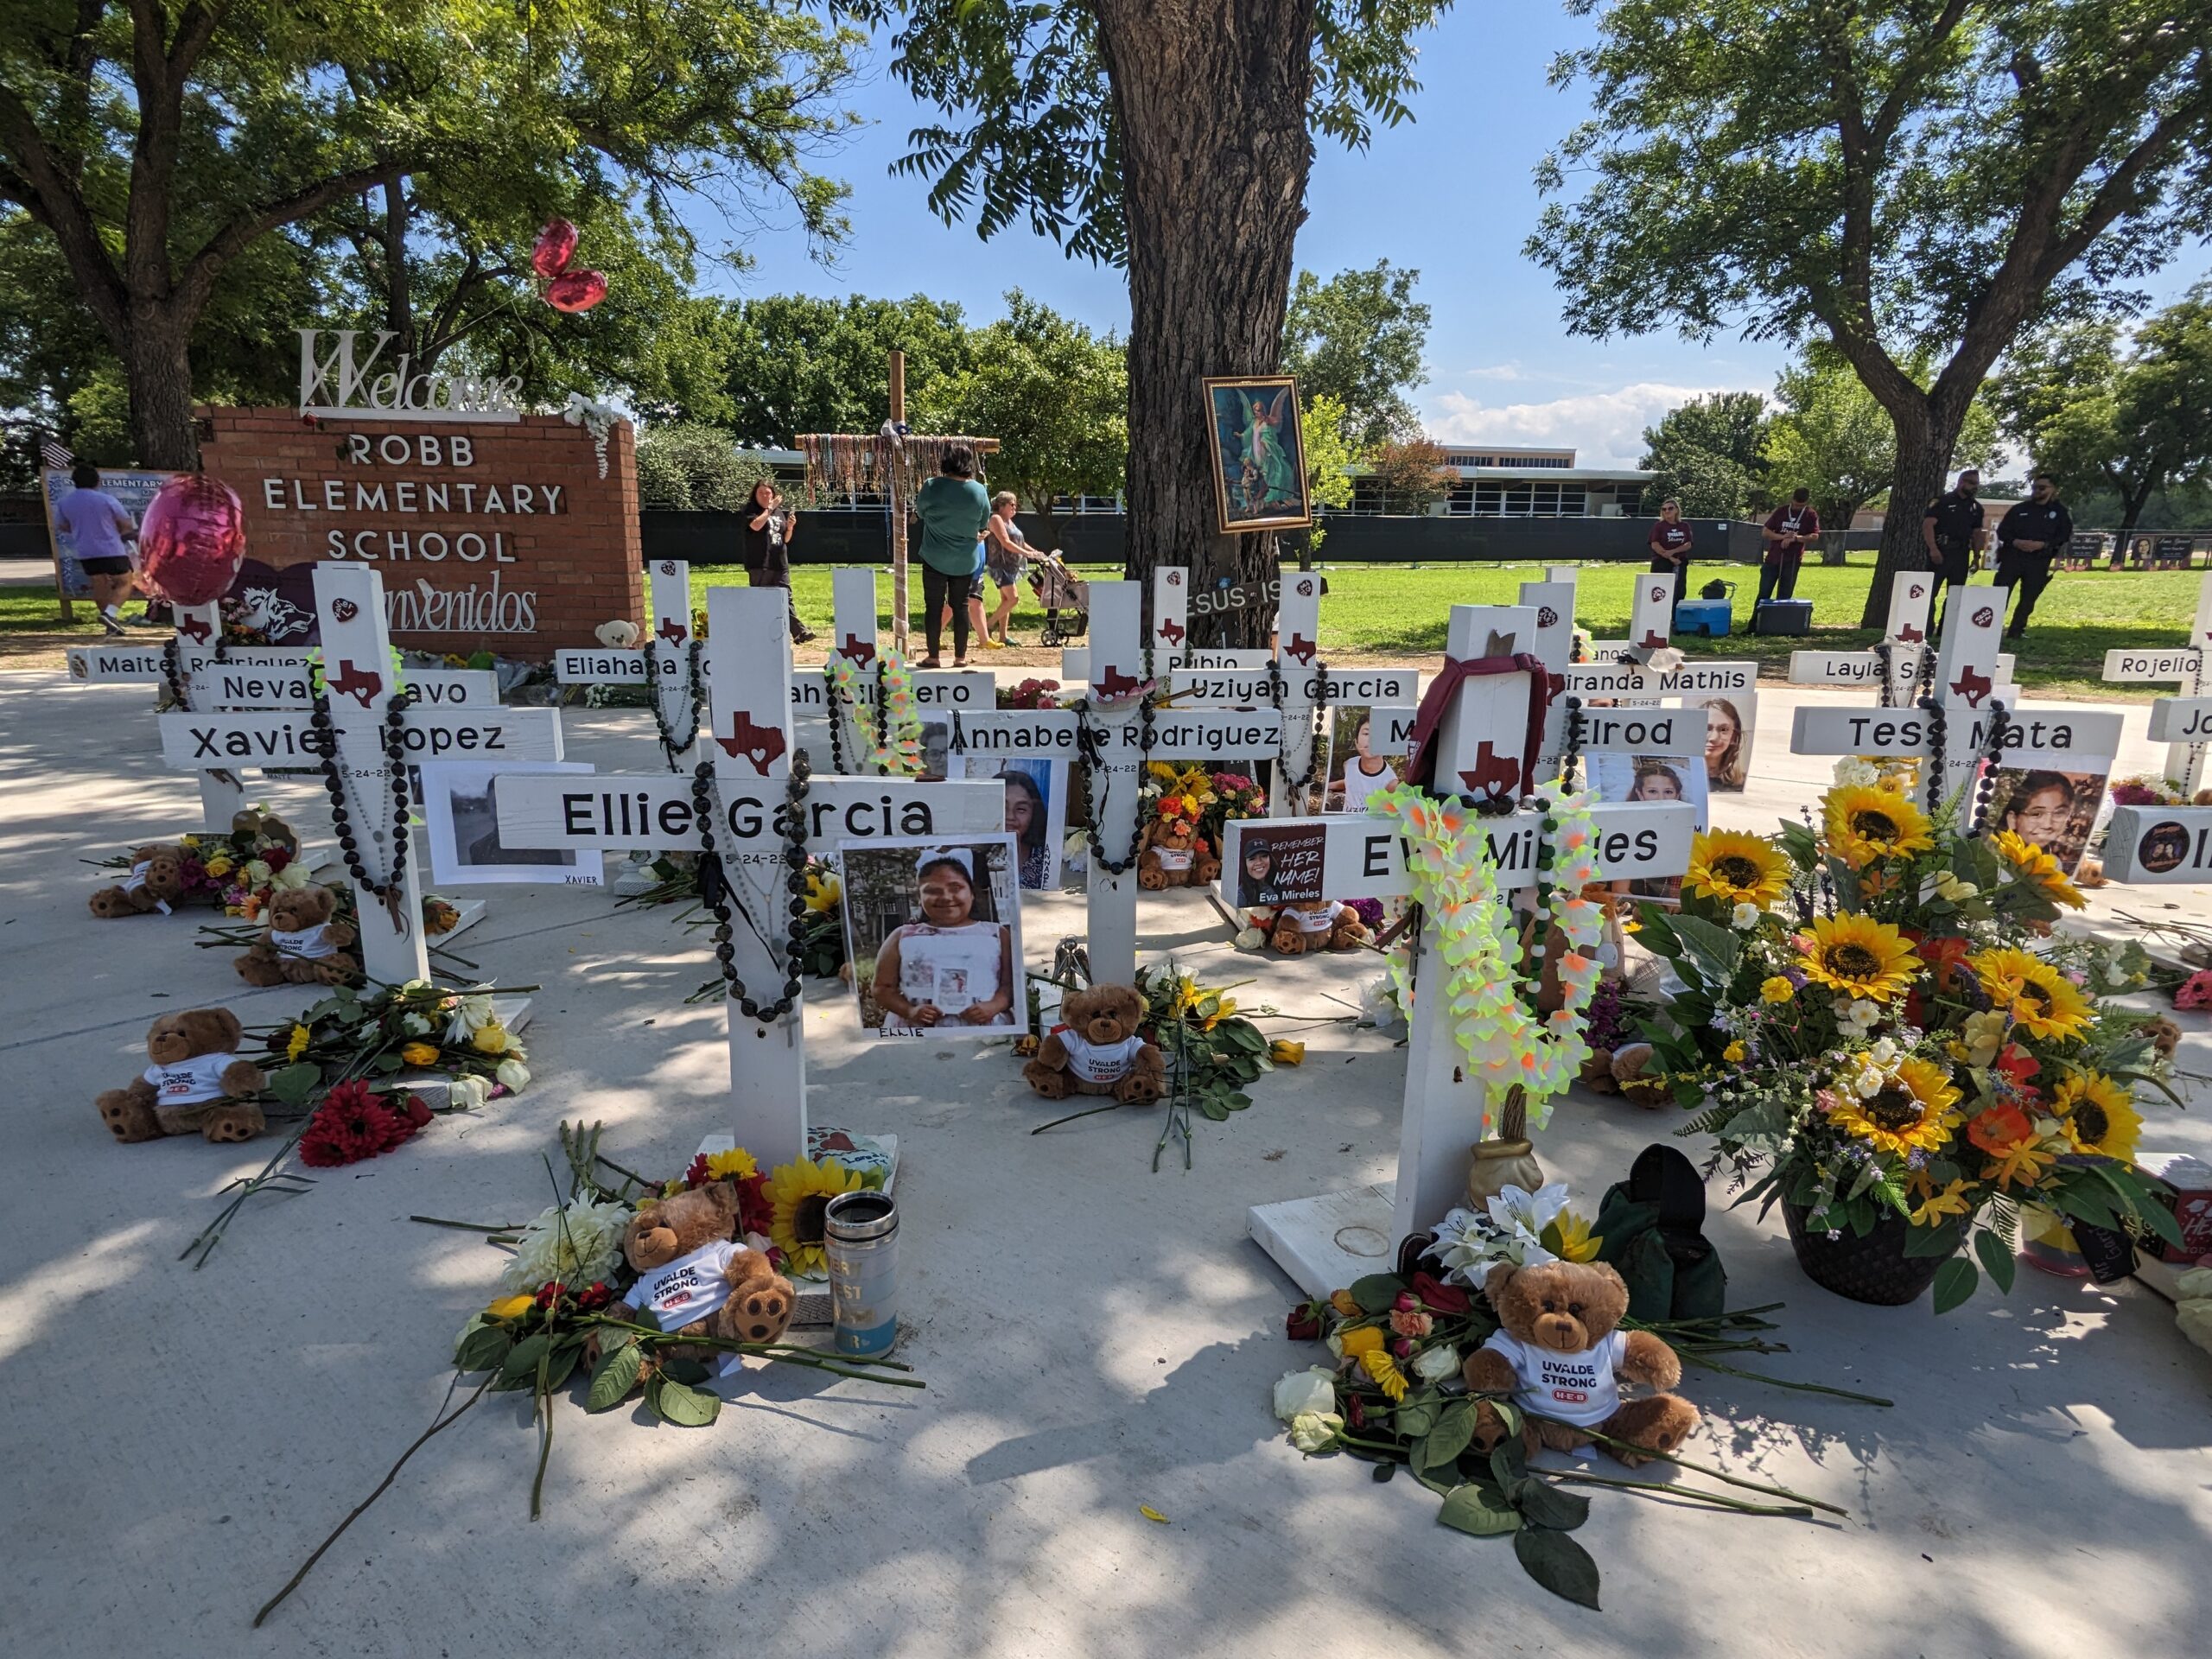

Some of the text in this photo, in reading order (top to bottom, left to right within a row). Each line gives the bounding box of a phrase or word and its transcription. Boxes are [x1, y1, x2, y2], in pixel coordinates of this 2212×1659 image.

[294, 328, 524, 411] Welcome
[349, 435, 474, 467] ROBB
[102, 480, 163, 489] LEMENTARY
[264, 479, 562, 515] ELEMENTARY
[327, 530, 516, 562] SCHOOL
[384, 569, 537, 632] nvenidos
[99, 657, 173, 674] Maite
[1826, 660, 1885, 680] Layla
[2120, 657, 2198, 678] Rojelio
[223, 676, 467, 704] Neva avo
[1303, 678, 1401, 699] Garcia
[1566, 670, 1745, 691] iranda Mathis
[1122, 724, 1279, 752] Rodriguez
[1576, 718, 1674, 746] Elrod
[1968, 720, 2074, 750] Mata
[341, 769, 391, 779] 5-24-22
[1094, 765, 1137, 773] 5-24-22
[563, 791, 934, 839] Ellie Garcia
[1271, 836, 1325, 851] REMEMBER
[726, 854, 787, 865] 5-24-22
[1281, 850, 1320, 868] HER
[564, 874, 598, 886] XAVIER
[1273, 867, 1320, 887] NAME!
[1259, 887, 1320, 903] Eva Mireles
[879, 1027, 925, 1039] ELLIE
[1089, 1058, 1122, 1067] UVALDE
[653, 1266, 696, 1291] UVALDE
[653, 1277, 699, 1302] STRONG
[1541, 1360, 1596, 1376] UVALDE
[1541, 1372, 1598, 1389] STRONG
